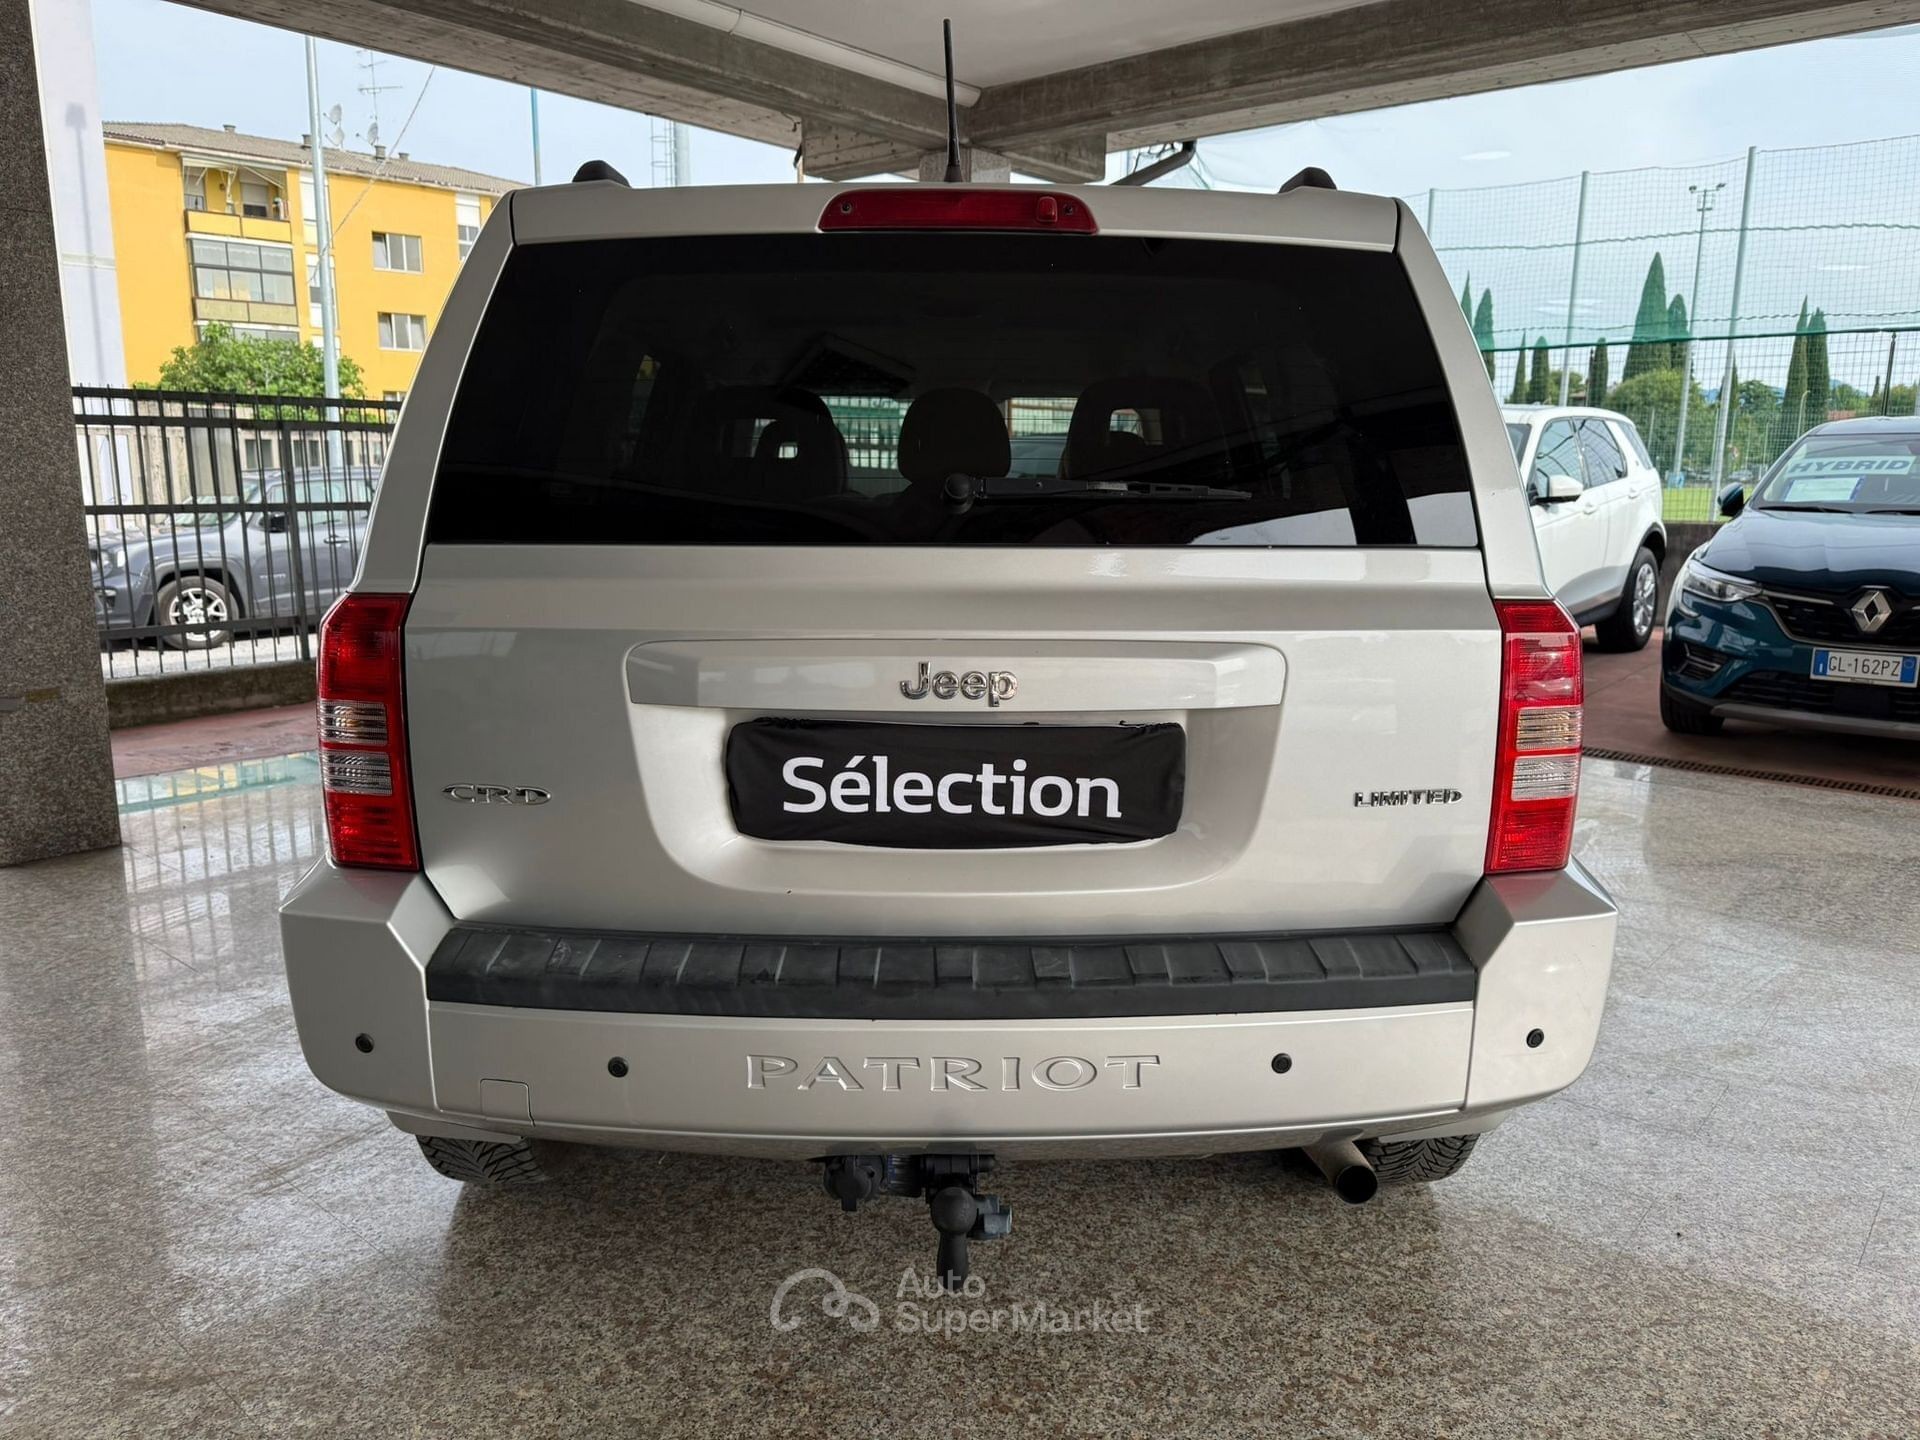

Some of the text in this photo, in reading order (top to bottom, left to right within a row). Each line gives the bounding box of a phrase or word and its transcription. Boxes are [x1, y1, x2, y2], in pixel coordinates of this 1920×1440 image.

[1788, 460, 1910, 473] HYBRID
[900, 661, 1018, 707] Jeep
[441, 784, 553, 805] CRD
[782, 755, 1122, 819] Sélection
[1353, 789, 1463, 807] LIMITED
[745, 1054, 1160, 1091] PATRIOT
